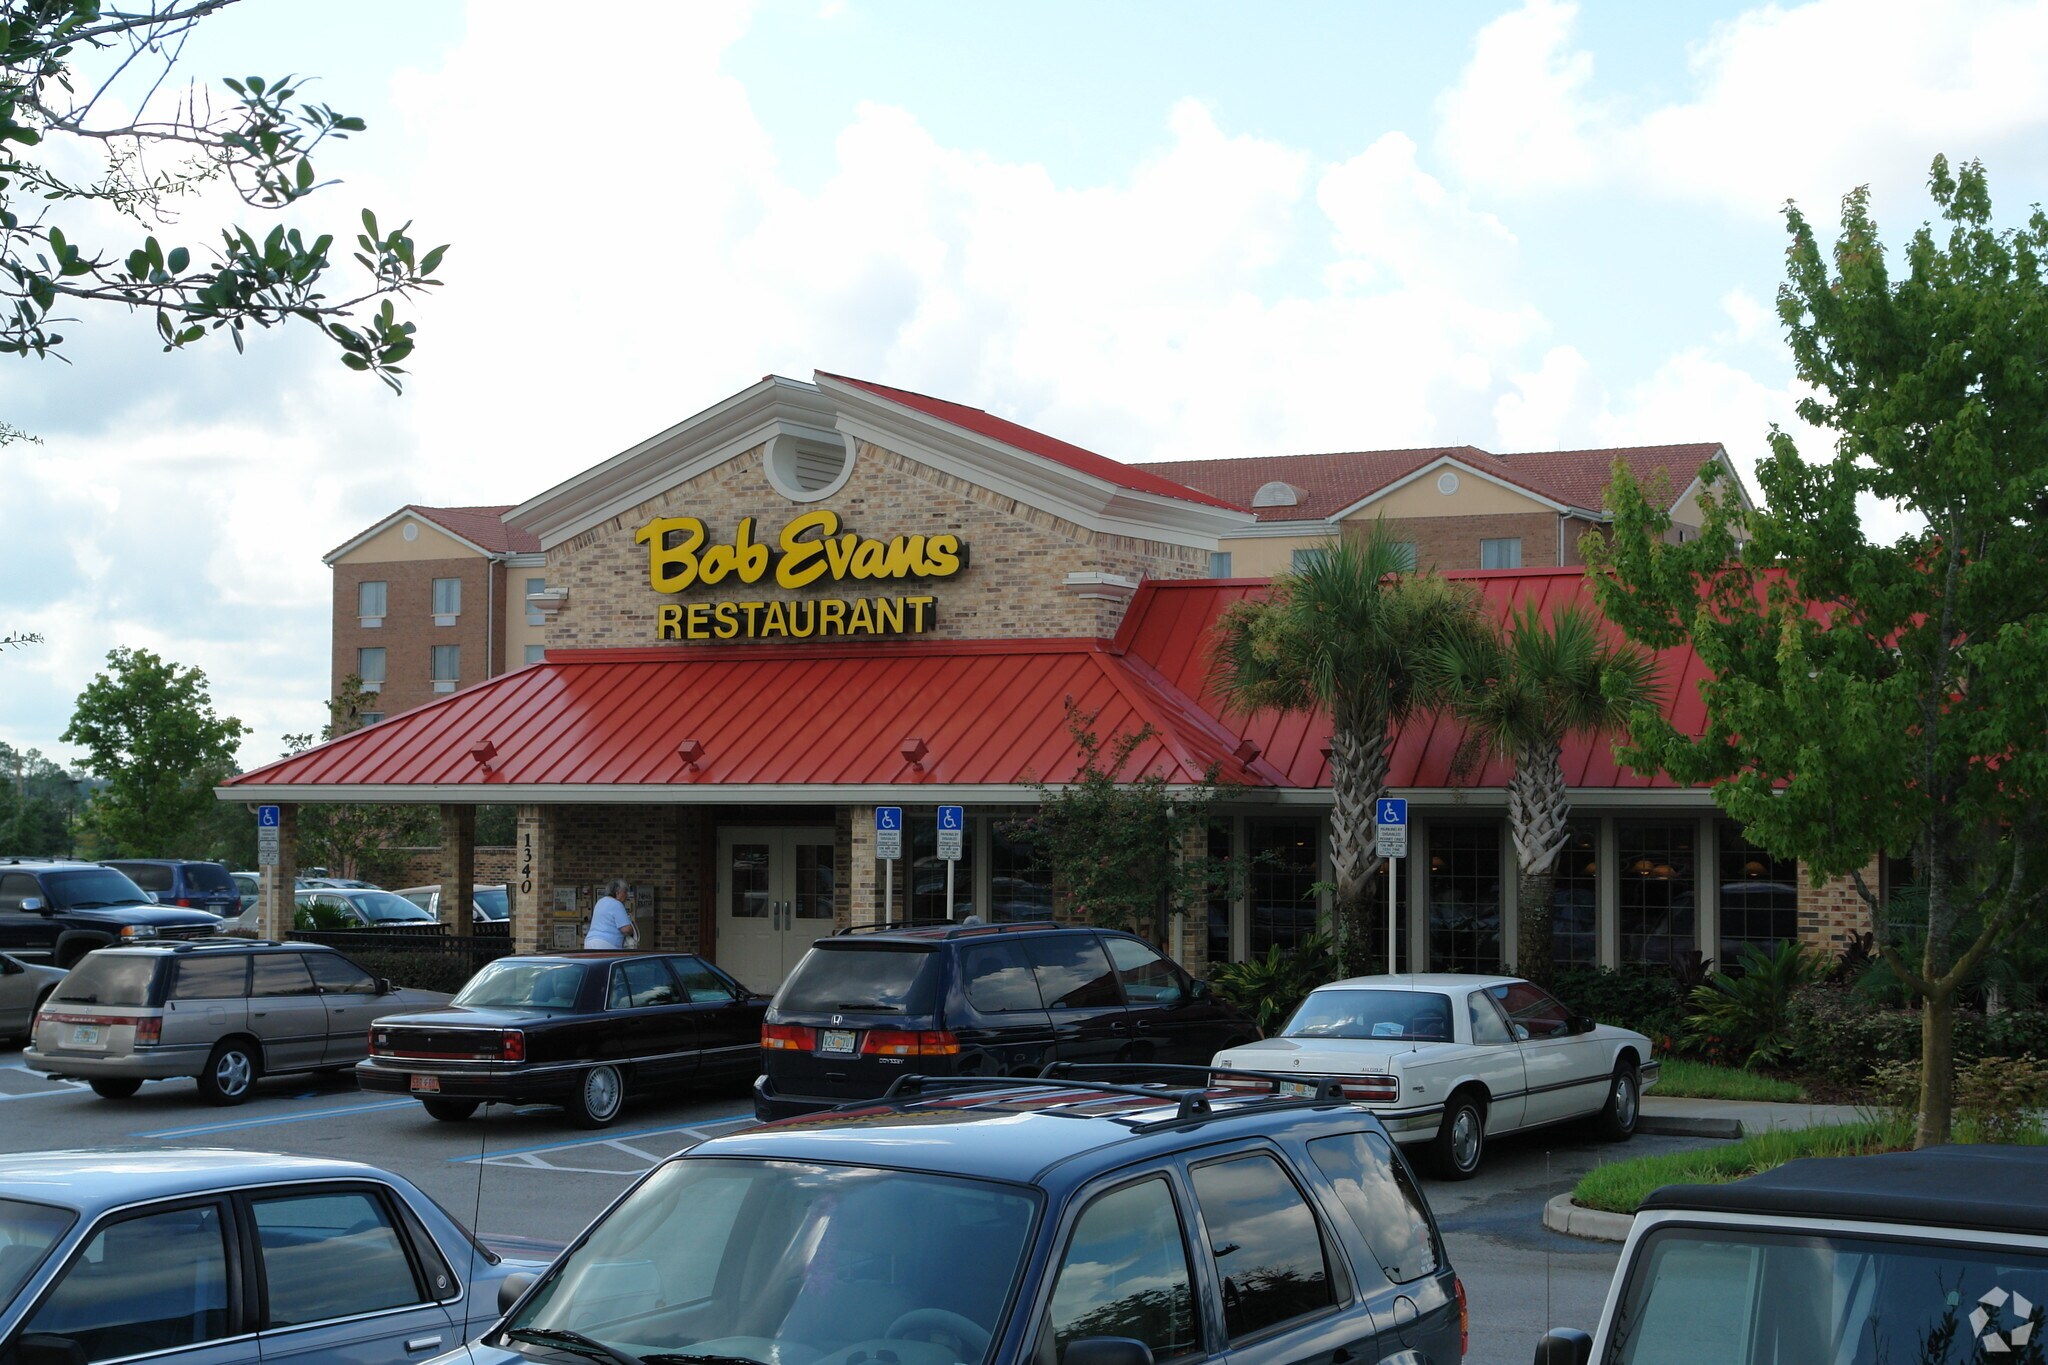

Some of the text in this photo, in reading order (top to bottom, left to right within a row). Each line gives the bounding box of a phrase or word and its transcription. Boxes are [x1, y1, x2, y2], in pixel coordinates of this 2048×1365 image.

[635, 510, 962, 594] Bob Evans
[658, 596, 935, 640] RESTAURANT
[521, 833, 532, 894] 1340
